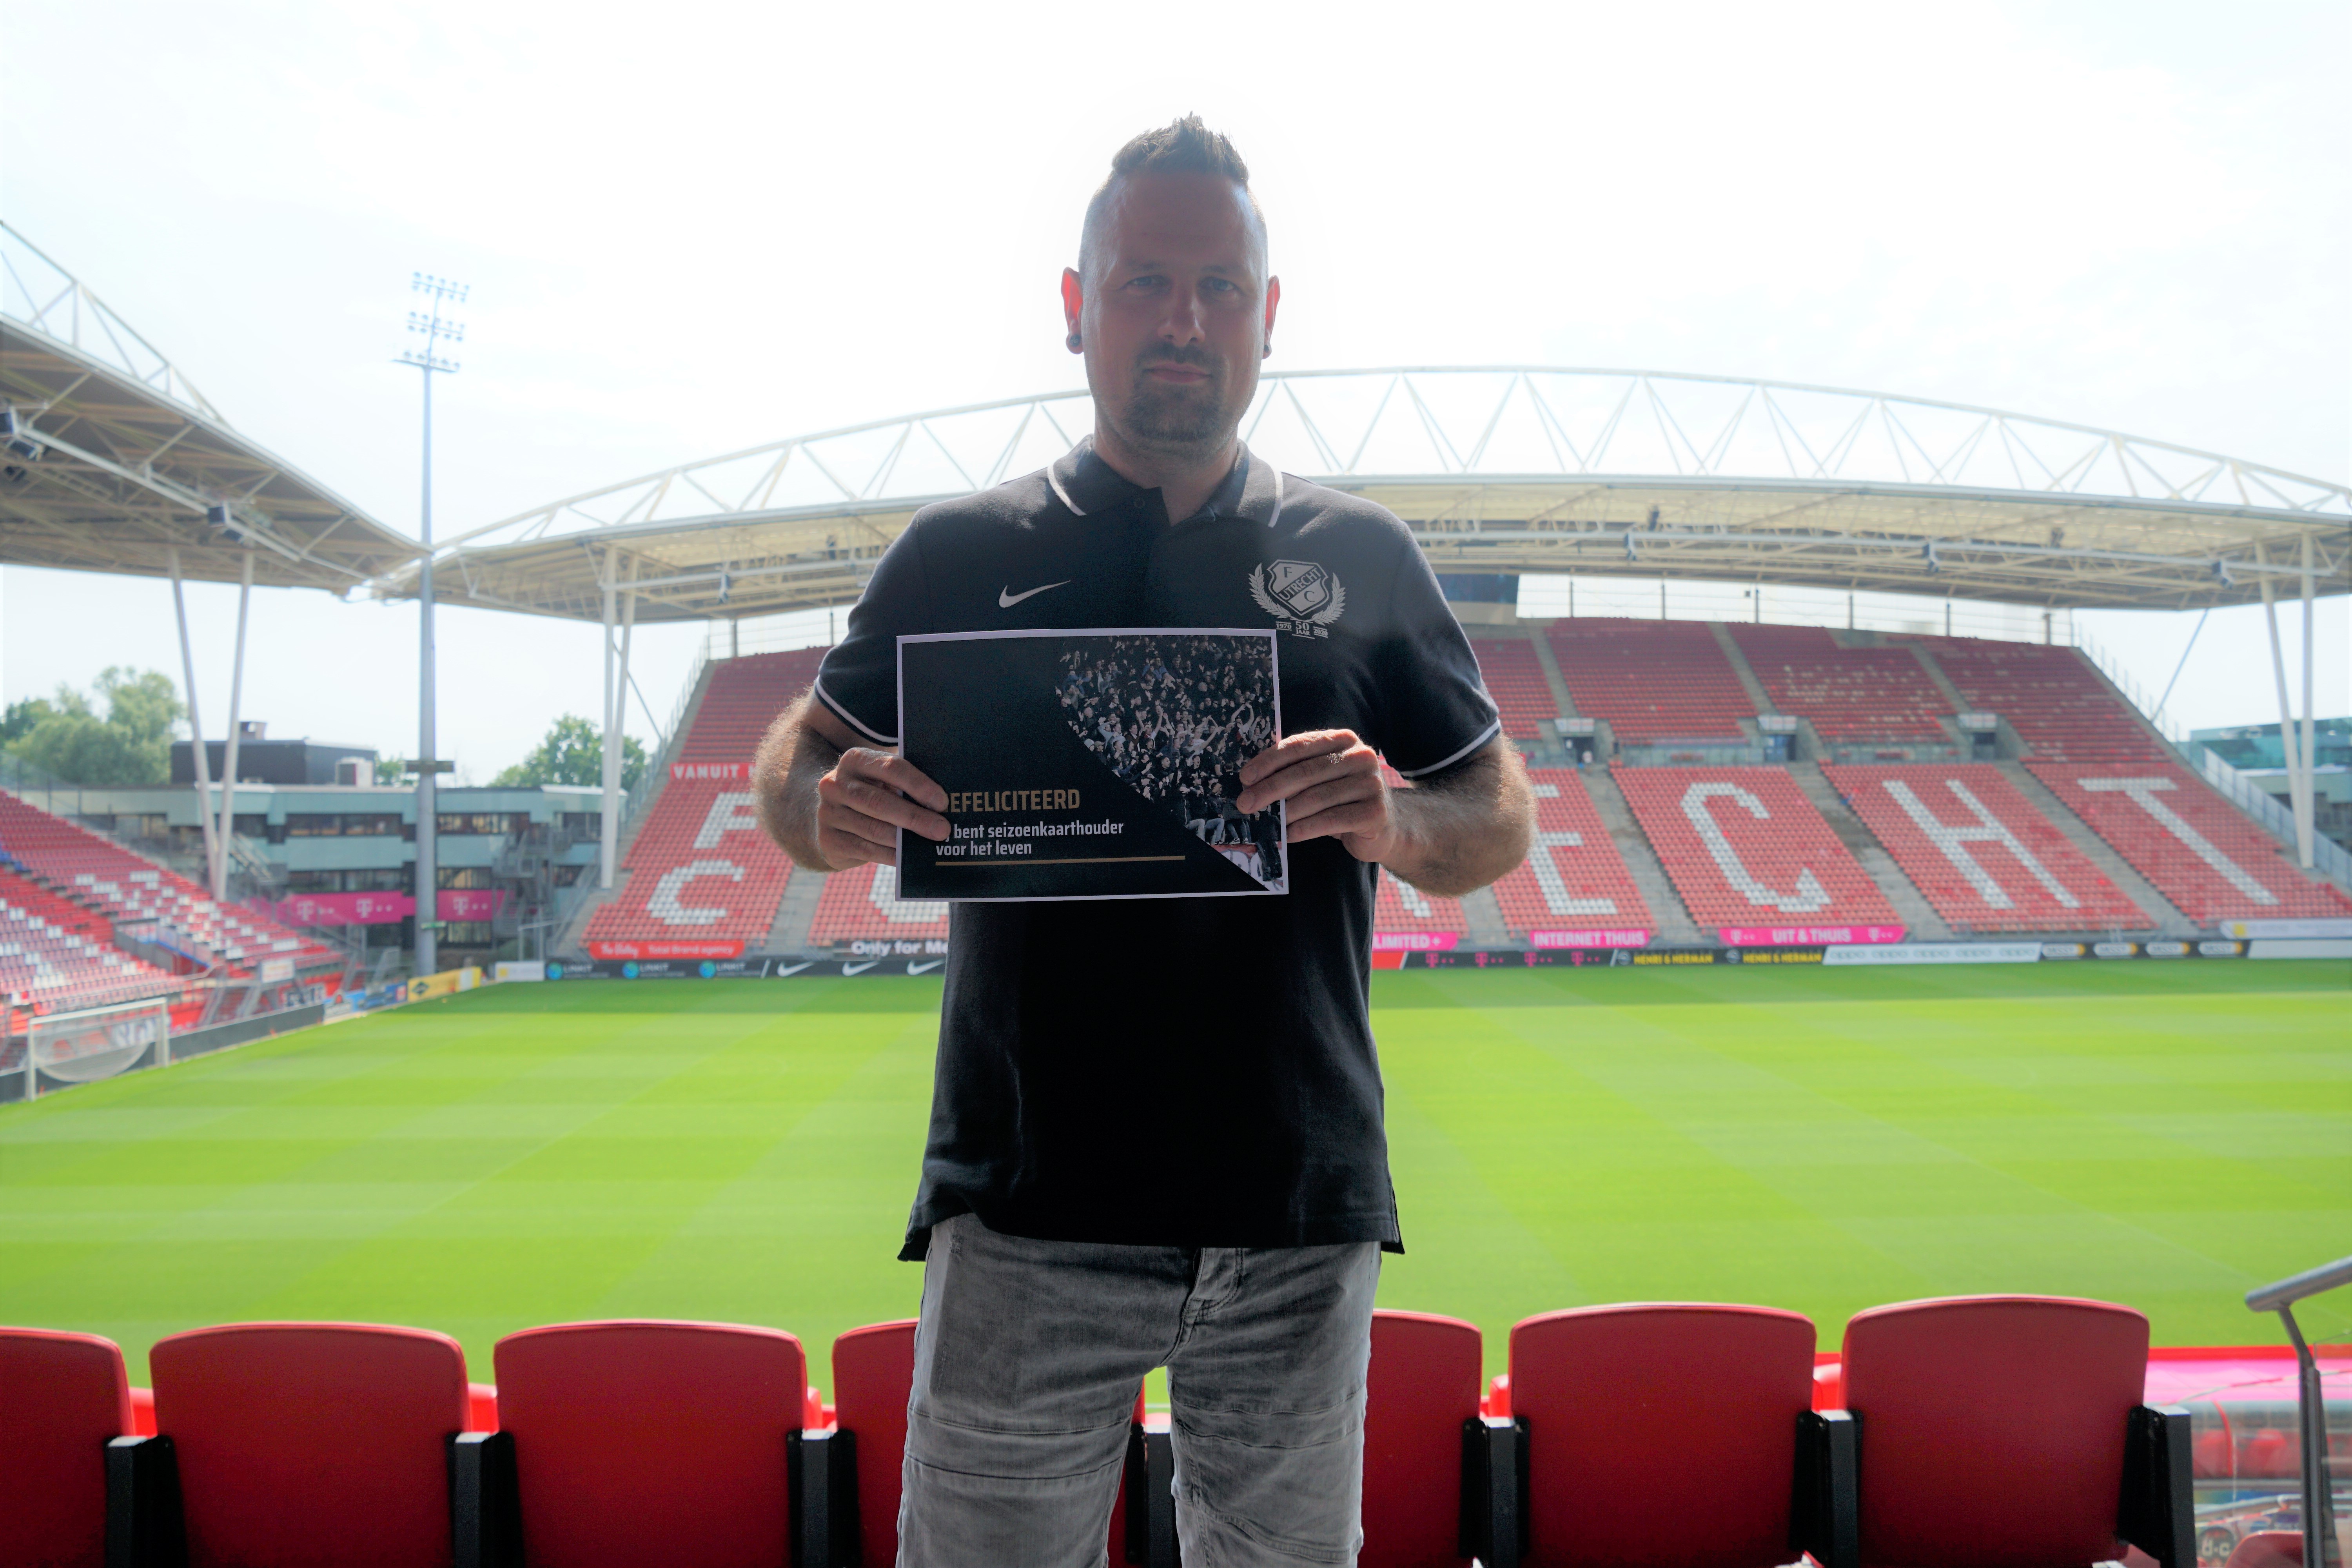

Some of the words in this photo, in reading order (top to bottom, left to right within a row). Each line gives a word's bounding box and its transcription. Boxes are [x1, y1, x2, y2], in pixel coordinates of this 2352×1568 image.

[1283, 566, 1292, 578] F
[1278, 568, 1321, 600] UTRECHT
[1304, 590, 1315, 603] C
[1295, 621, 1310, 631] 50
[673, 765, 739, 779] VANUIT
[943, 789, 1080, 813] EFELICITEERD
[954, 824, 984, 838] bent
[988, 819, 1124, 838] seizoenkaarthouder
[936, 845, 966, 856] voor
[970, 841, 992, 855] het
[996, 840, 1032, 855] leven
[1534, 933, 1601, 947] INTERNET
[1602, 931, 1644, 946] THUIS
[1772, 929, 1795, 943] UIT
[1809, 928, 1851, 943] THUIS
[851, 940, 892, 957] Only
[894, 939, 922, 954] for
